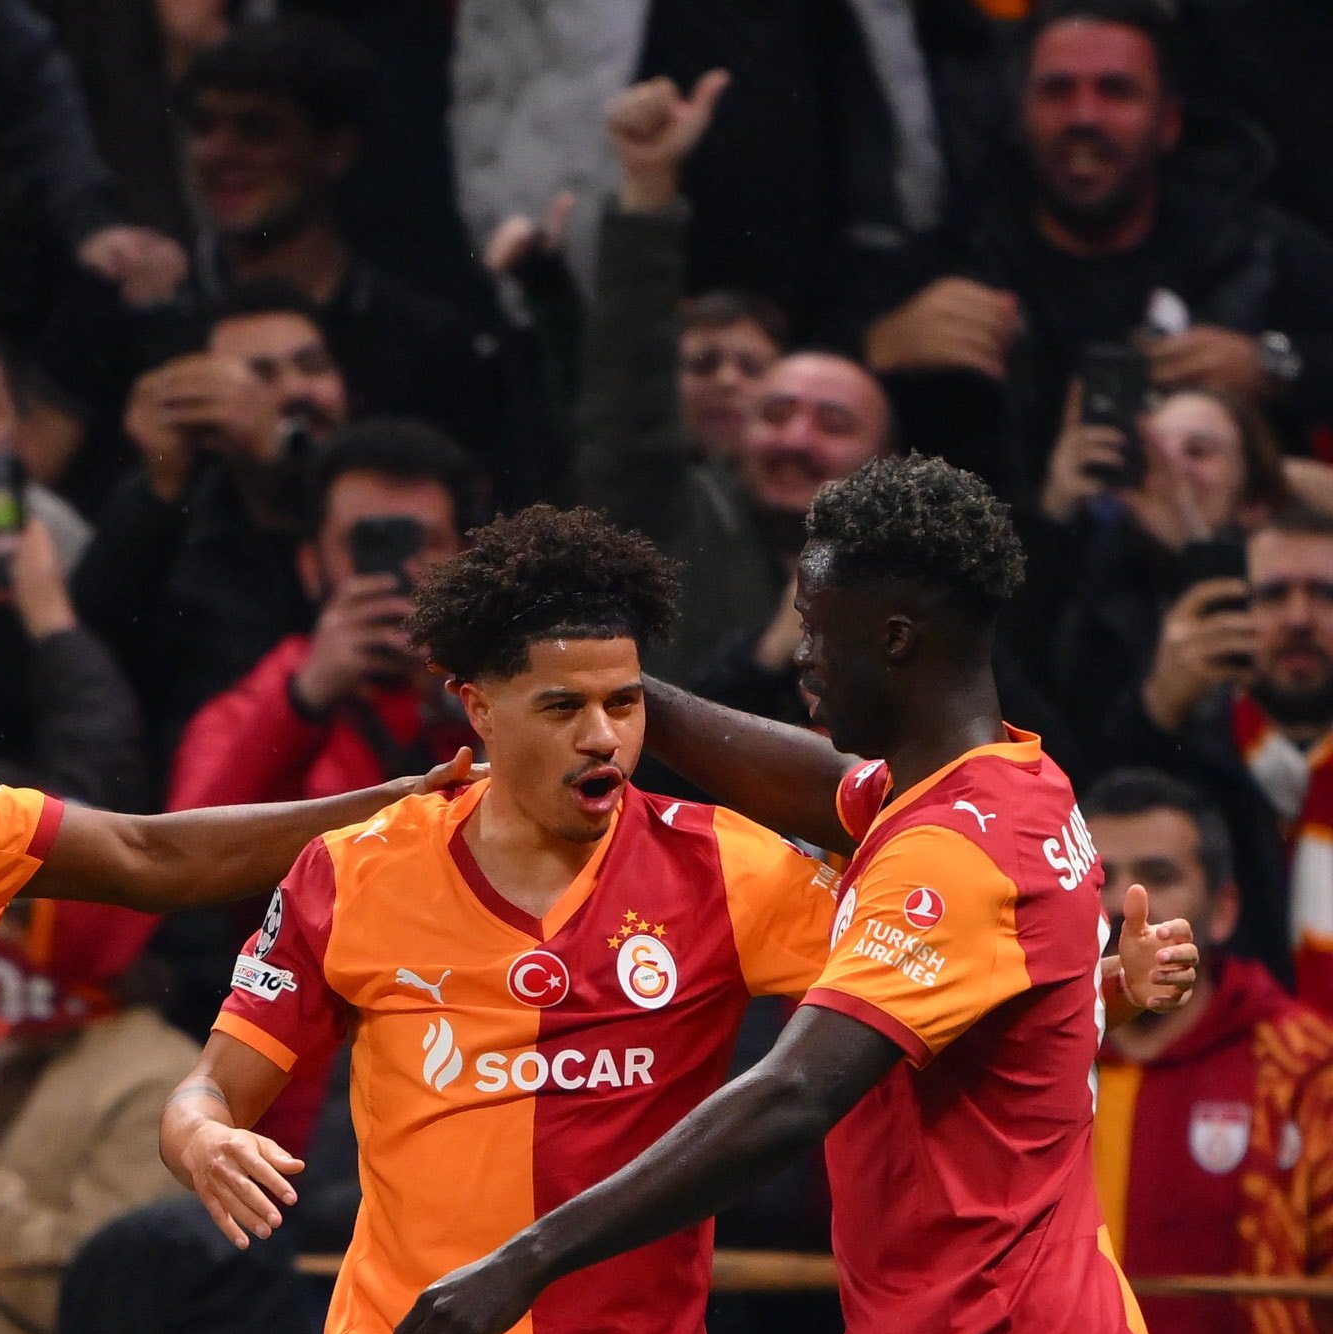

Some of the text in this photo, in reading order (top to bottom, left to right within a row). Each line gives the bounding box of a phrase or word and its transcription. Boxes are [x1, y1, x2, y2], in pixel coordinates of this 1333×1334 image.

[852, 937, 937, 988] AIRLINES
[865, 918, 946, 973] TURKISH
[473, 1046, 656, 1094] SOCAR
